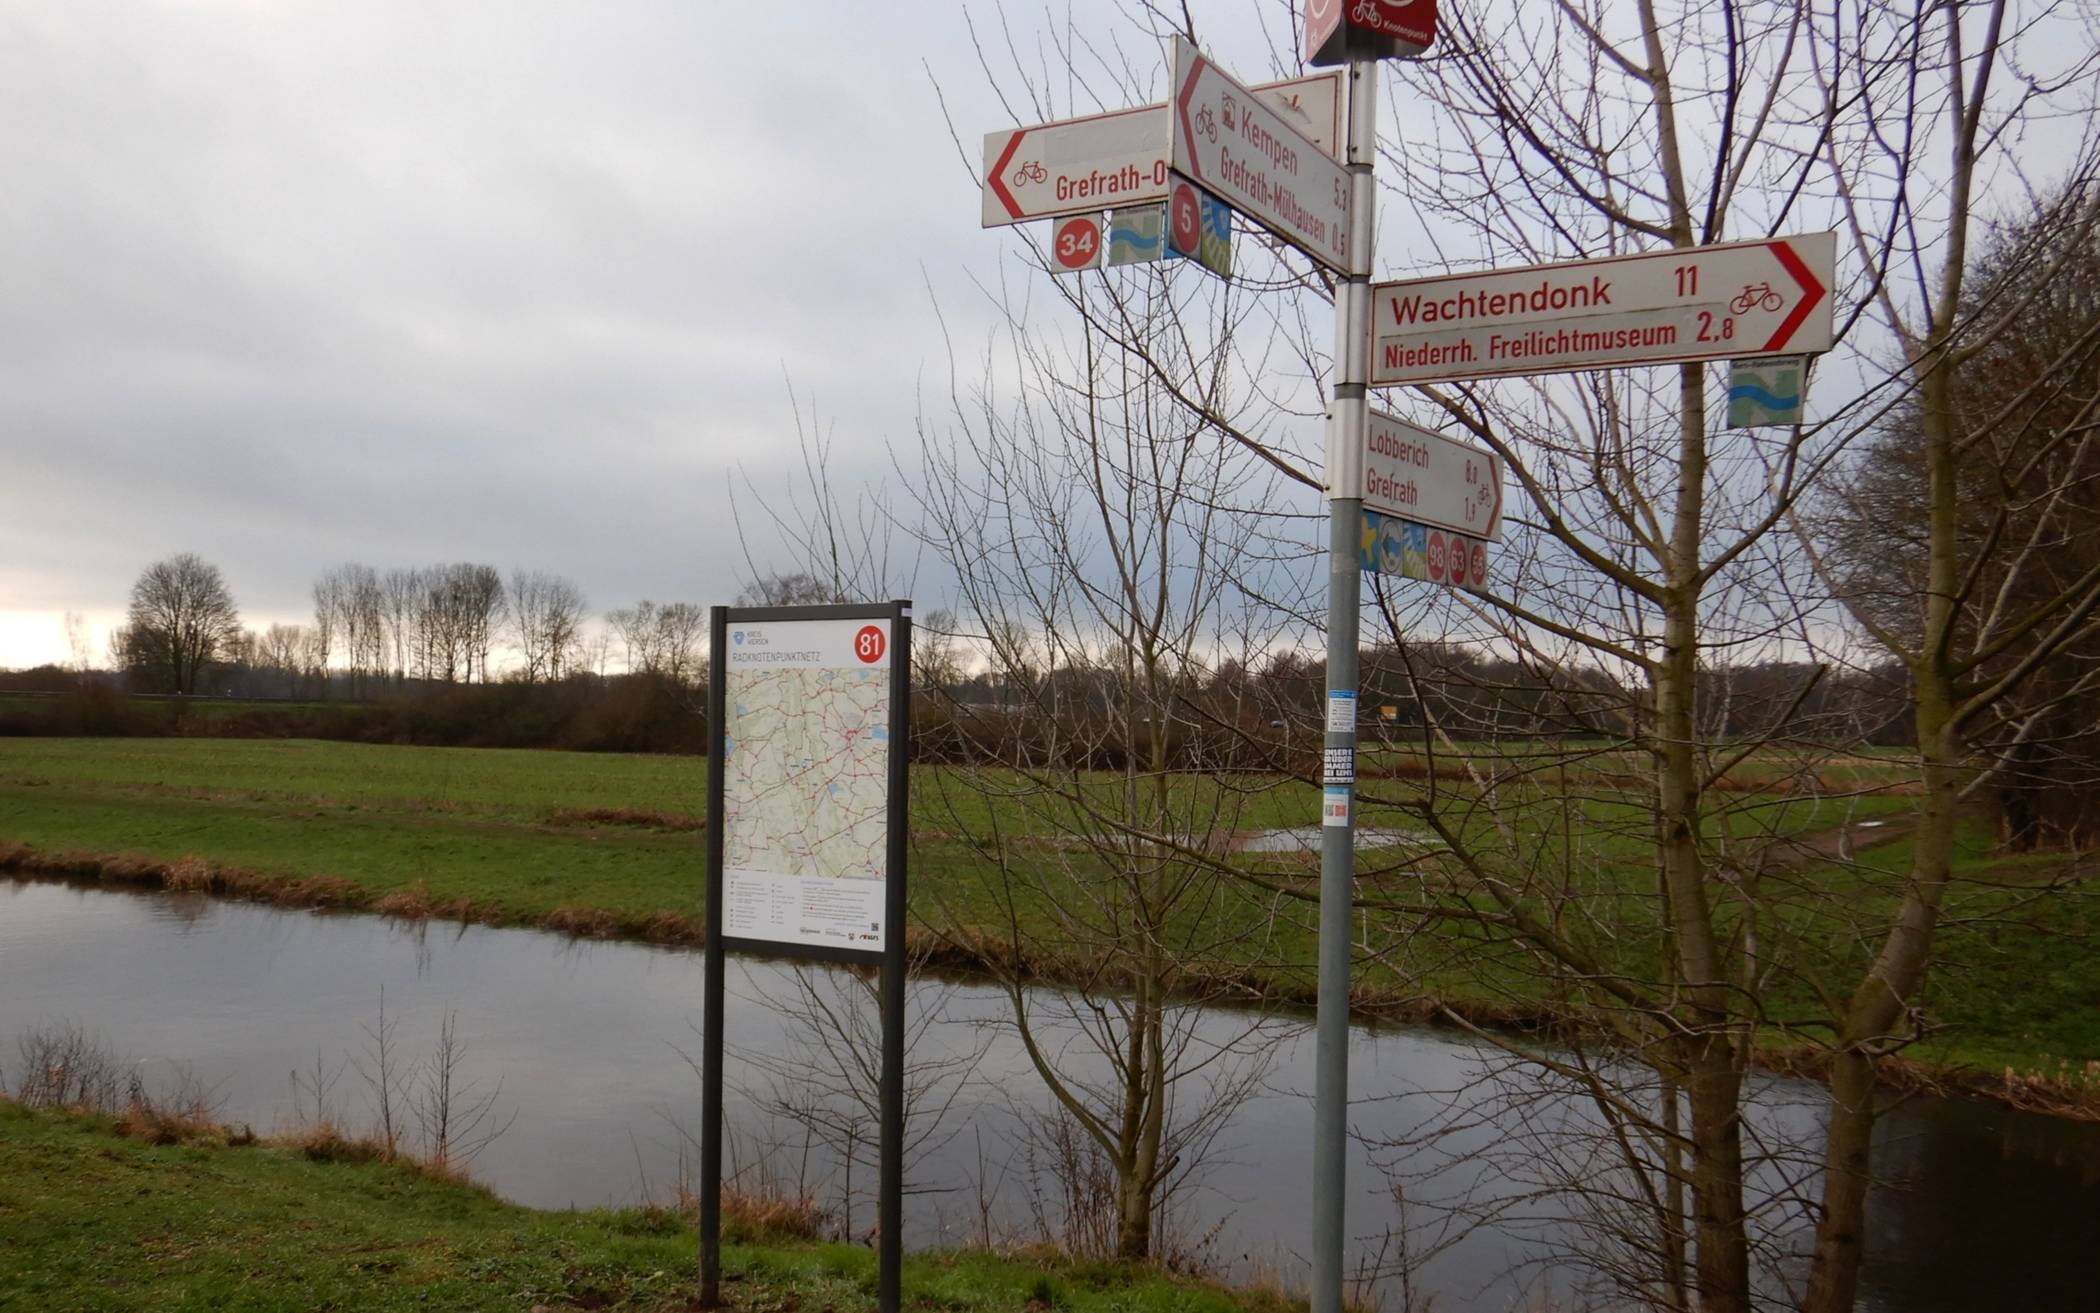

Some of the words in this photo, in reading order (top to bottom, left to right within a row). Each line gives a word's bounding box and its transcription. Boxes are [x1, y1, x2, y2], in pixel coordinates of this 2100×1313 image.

[1241, 106, 1298, 176] Kempen
[1221, 146, 1326, 243] Grefrath-Mülhausen
[1181, 204, 1192, 233] 5
[1060, 230, 1093, 256] 34
[1391, 276, 1611, 326] Wachtendonk
[1674, 265, 1697, 297] 11
[1385, 338, 1478, 369] Niederrh.
[1489, 325, 1676, 360] Freilichtmuseum
[1696, 311, 1733, 343] 2,8
[1369, 424, 1429, 469] Lobberich
[1367, 467, 1418, 505] Grefrath
[1429, 544, 1444, 568] 98
[1451, 549, 1465, 572] 63
[860, 633, 881, 656] 81
